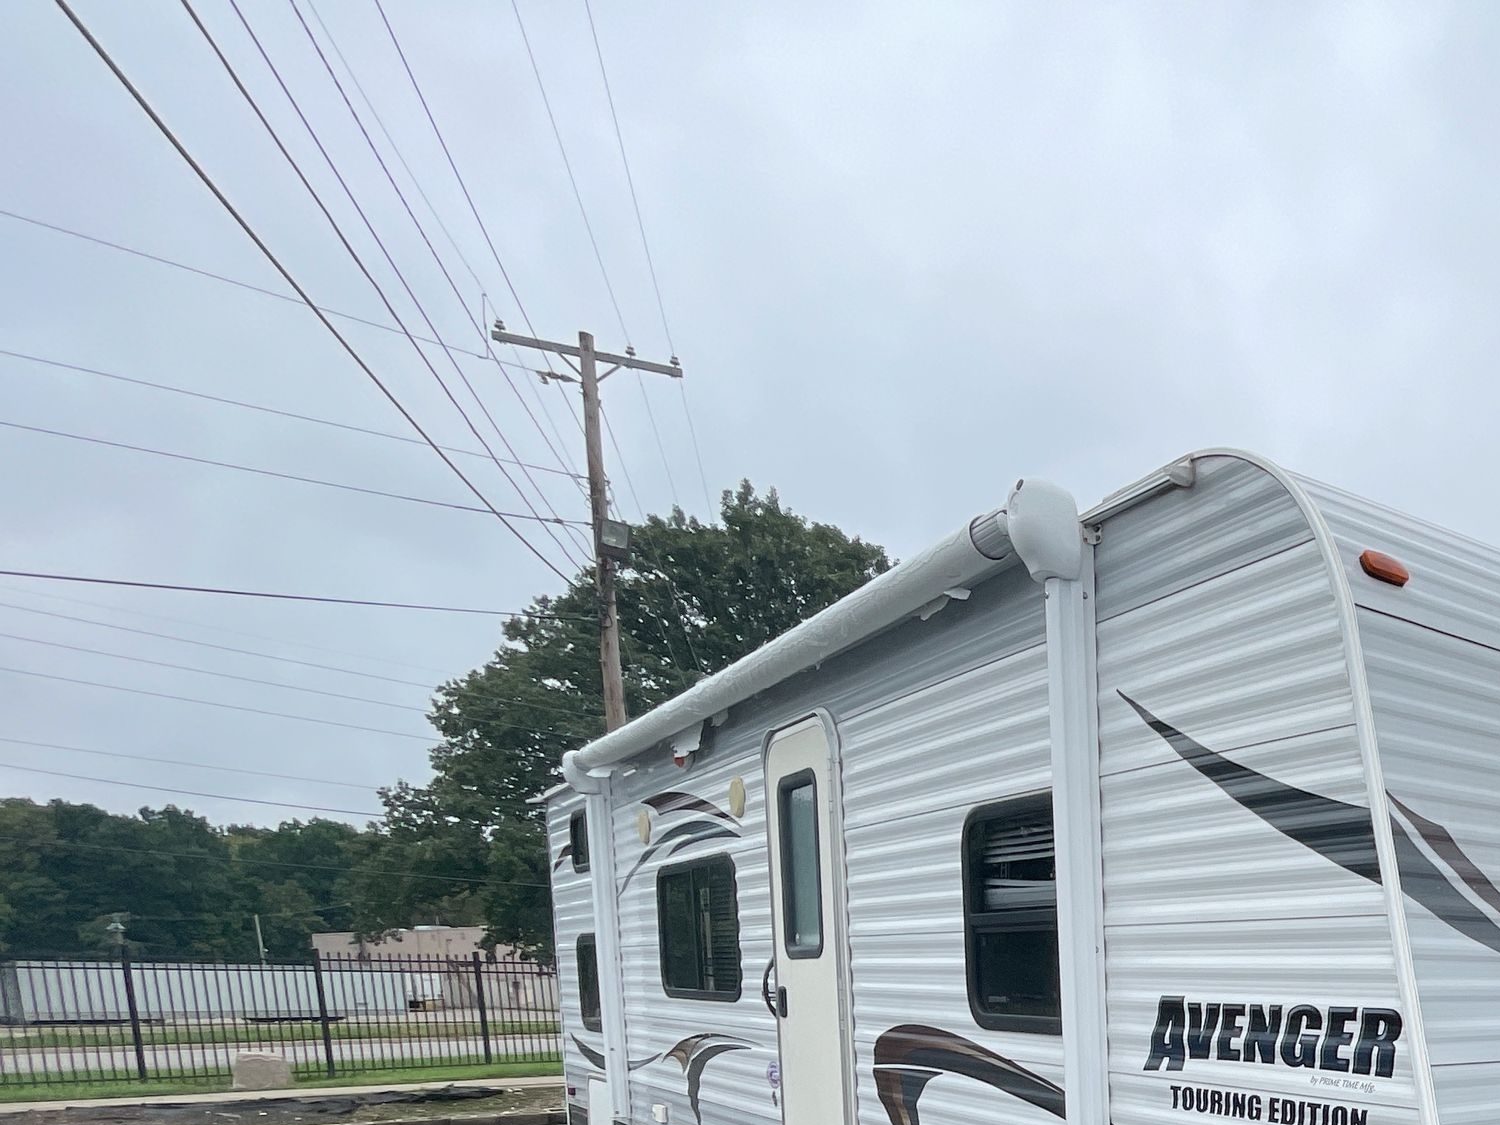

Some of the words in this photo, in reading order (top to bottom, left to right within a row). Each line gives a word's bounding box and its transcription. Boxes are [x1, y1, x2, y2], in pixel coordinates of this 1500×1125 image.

[1143, 995, 1403, 1079] AVENGER
[1310, 1075, 1319, 1086] by
[1319, 1077, 1341, 1088] PRIME
[1341, 1079, 1360, 1090] TIME
[1169, 1085, 1262, 1122] TOURING
